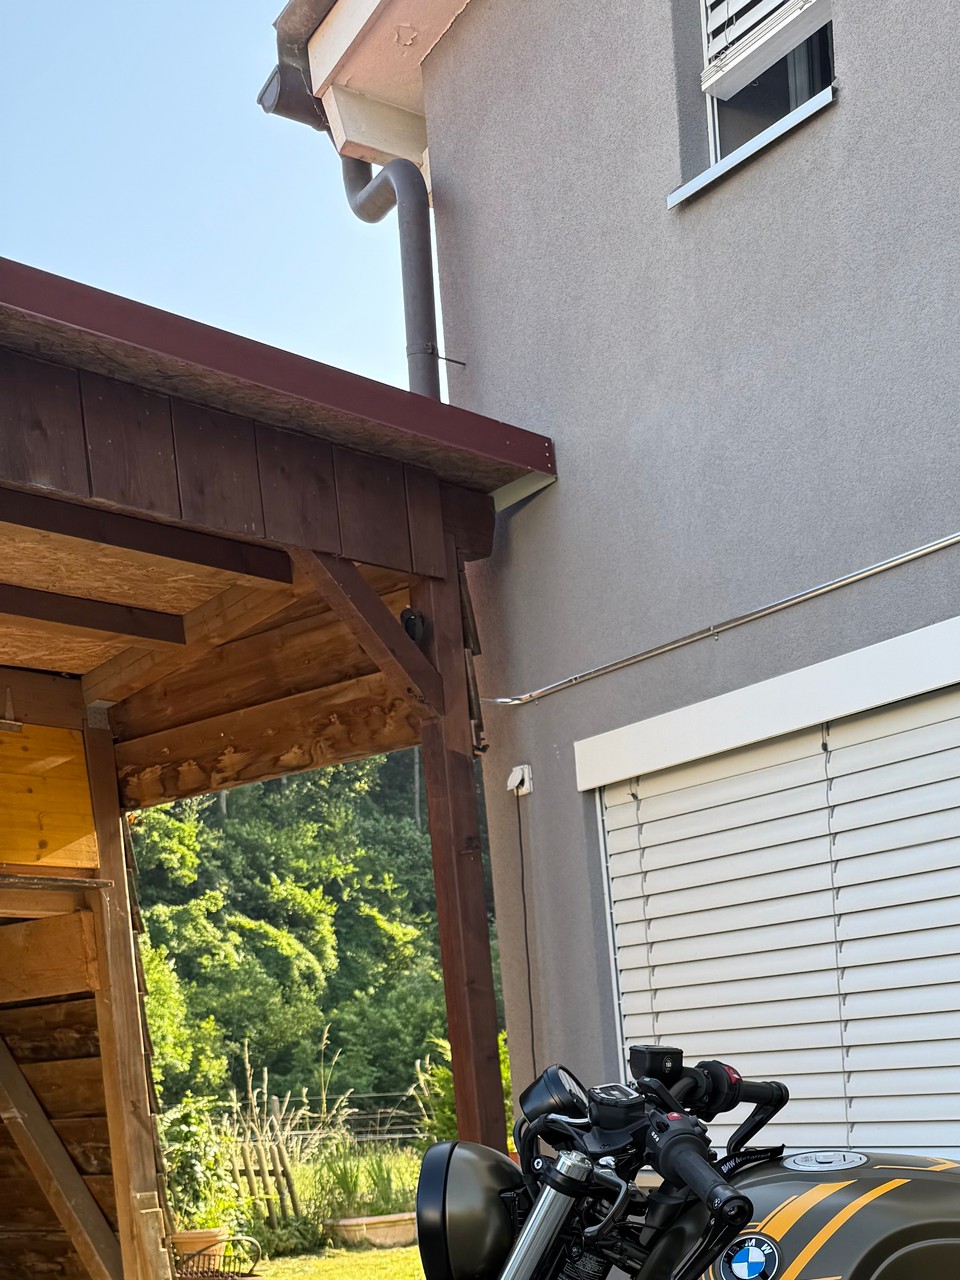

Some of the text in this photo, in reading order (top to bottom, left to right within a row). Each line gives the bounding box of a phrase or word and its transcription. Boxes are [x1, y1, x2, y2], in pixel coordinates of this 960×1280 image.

[721, 1152, 771, 1174] BMW Motorrad
[728, 1238, 773, 1255] BMW
